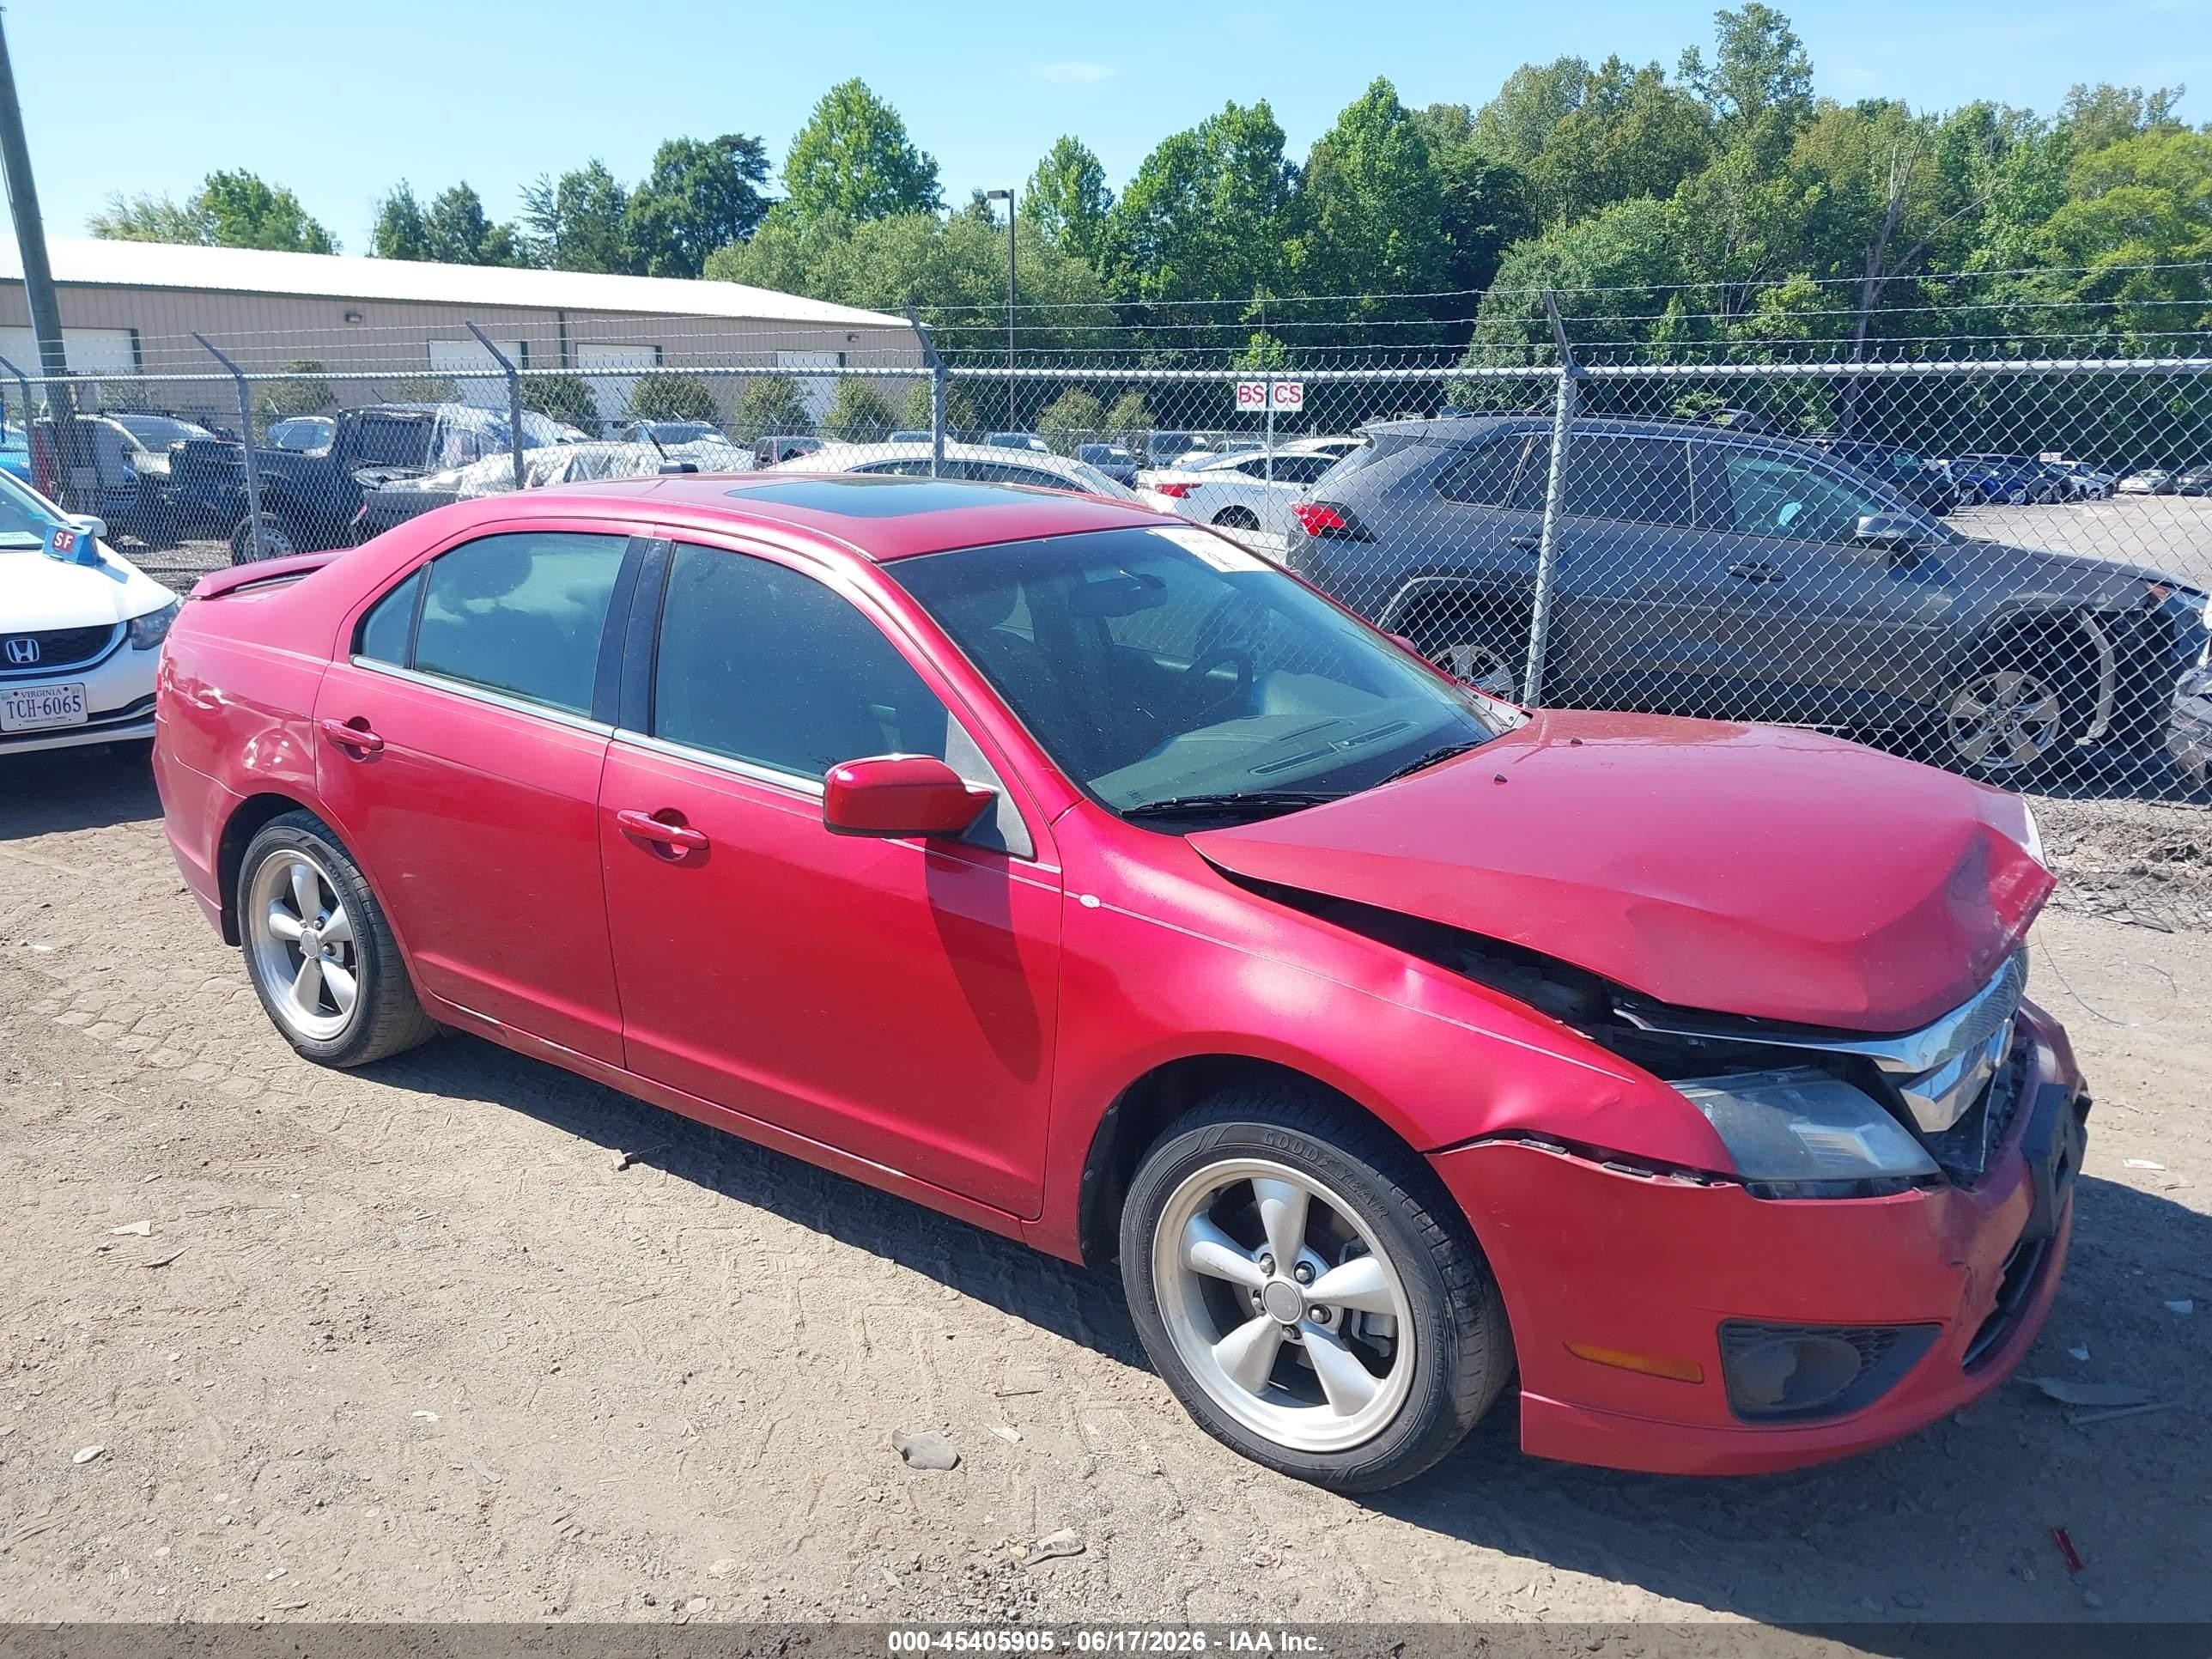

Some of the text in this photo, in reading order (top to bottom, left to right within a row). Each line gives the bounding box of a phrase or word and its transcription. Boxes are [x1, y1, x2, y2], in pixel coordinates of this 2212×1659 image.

[1238, 385, 1265, 404] BS
[1274, 385, 1302, 404] CS
[54, 532, 74, 550] SF
[21, 689, 63, 698] VIRGINIA
[6, 695, 82, 720] TCH-6065
